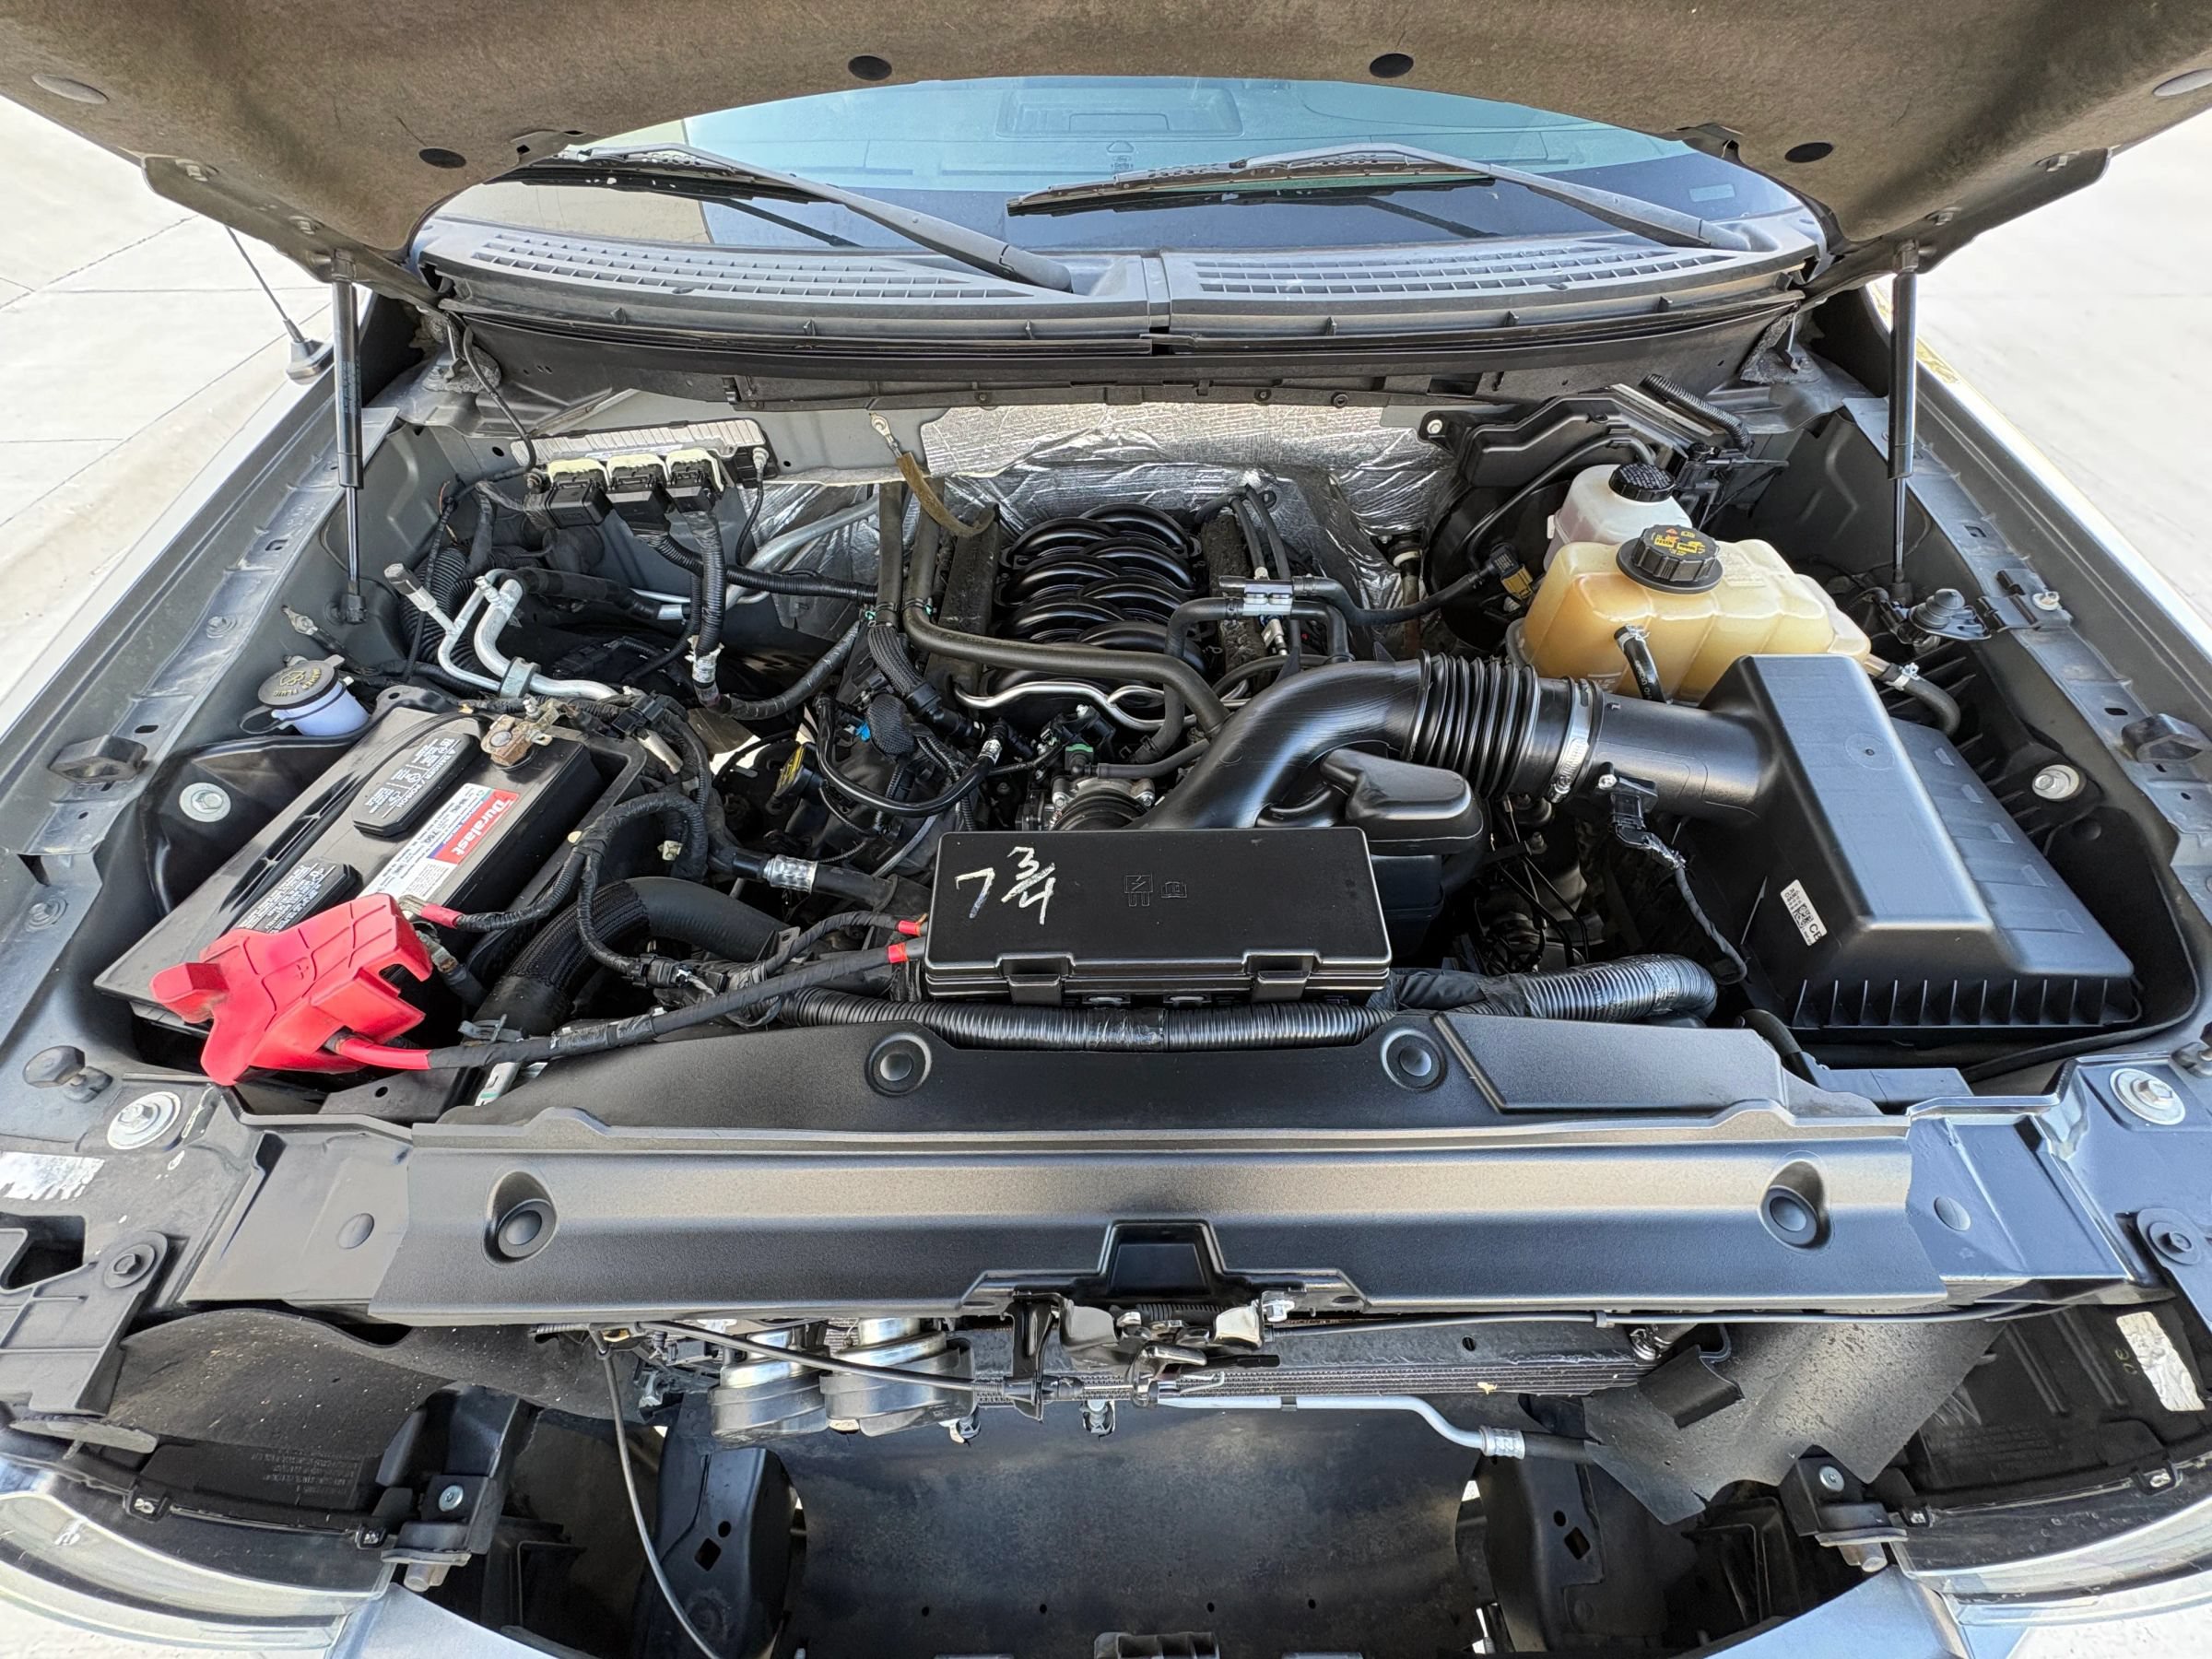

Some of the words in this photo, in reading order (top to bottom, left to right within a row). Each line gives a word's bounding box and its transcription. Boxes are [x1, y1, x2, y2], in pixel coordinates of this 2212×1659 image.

[424, 754, 451, 779] DANGER
[395, 783, 423, 807] POISON
[453, 798, 508, 854] Duralast
[955, 867, 995, 919] 7
